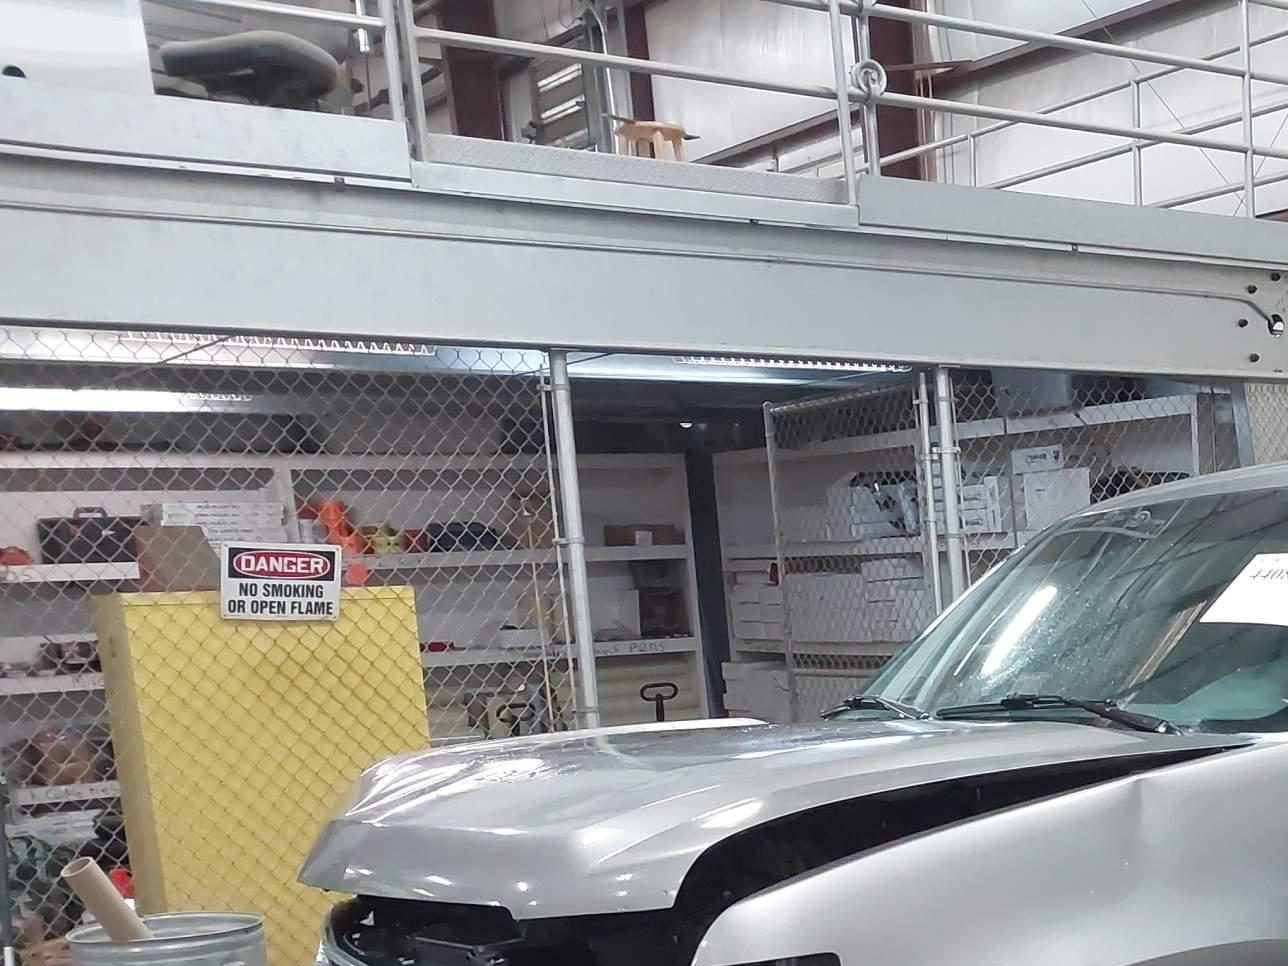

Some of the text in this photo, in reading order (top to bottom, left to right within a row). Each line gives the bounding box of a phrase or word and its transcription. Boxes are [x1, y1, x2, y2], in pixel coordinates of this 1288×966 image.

[240, 555, 324, 574] DANGER
[239, 582, 324, 599] NO SMOKING
[227, 599, 333, 616] OR OPEN FLAME
